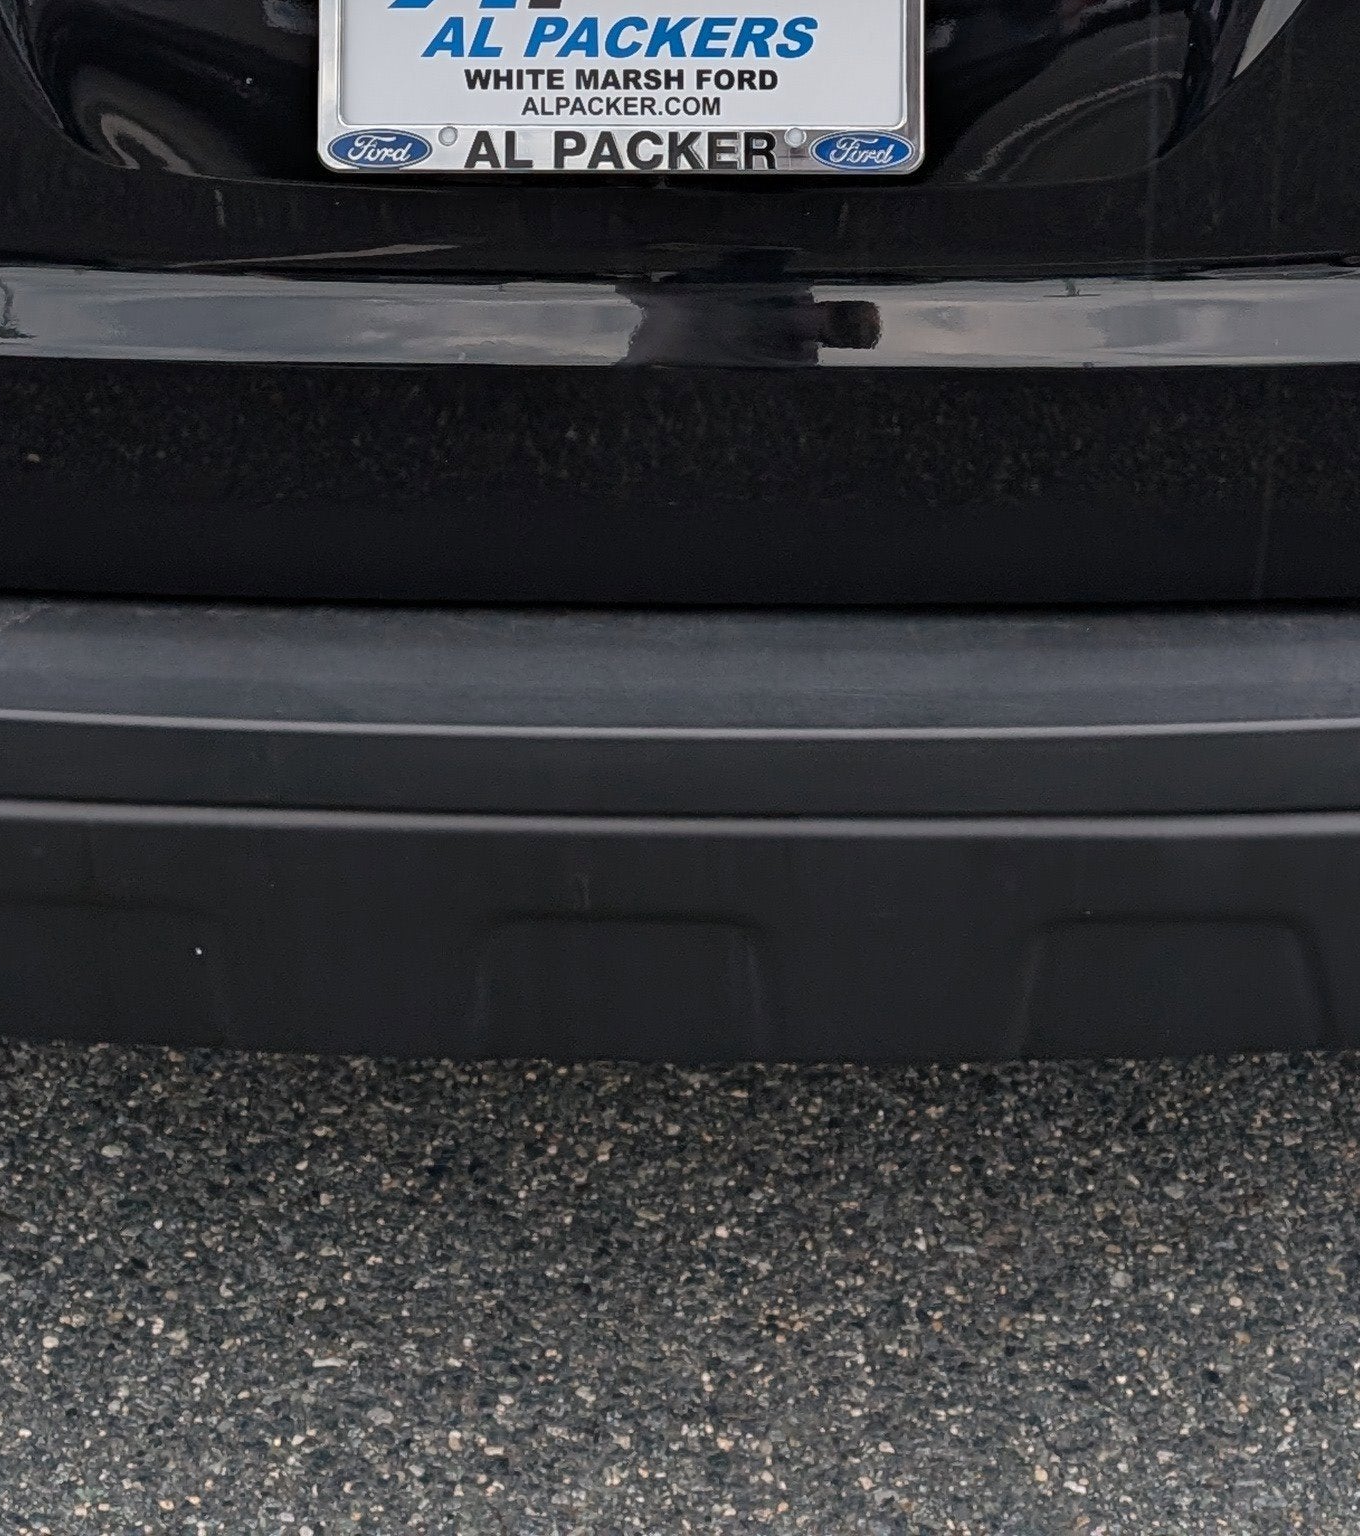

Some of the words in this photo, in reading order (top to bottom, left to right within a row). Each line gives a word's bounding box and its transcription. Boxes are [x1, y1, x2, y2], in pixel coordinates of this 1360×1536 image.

[421, 16, 503, 58] AL
[523, 16, 819, 59] PACKERS
[464, 69, 565, 90] WHITE
[575, 68, 685, 90] MARSH
[695, 68, 779, 91] FORD
[520, 96, 721, 117] ALPACKER.COM
[347, 133, 411, 163] Ford
[463, 130, 534, 169] AL
[553, 129, 778, 171] PACKER
[829, 136, 894, 165] Ford
